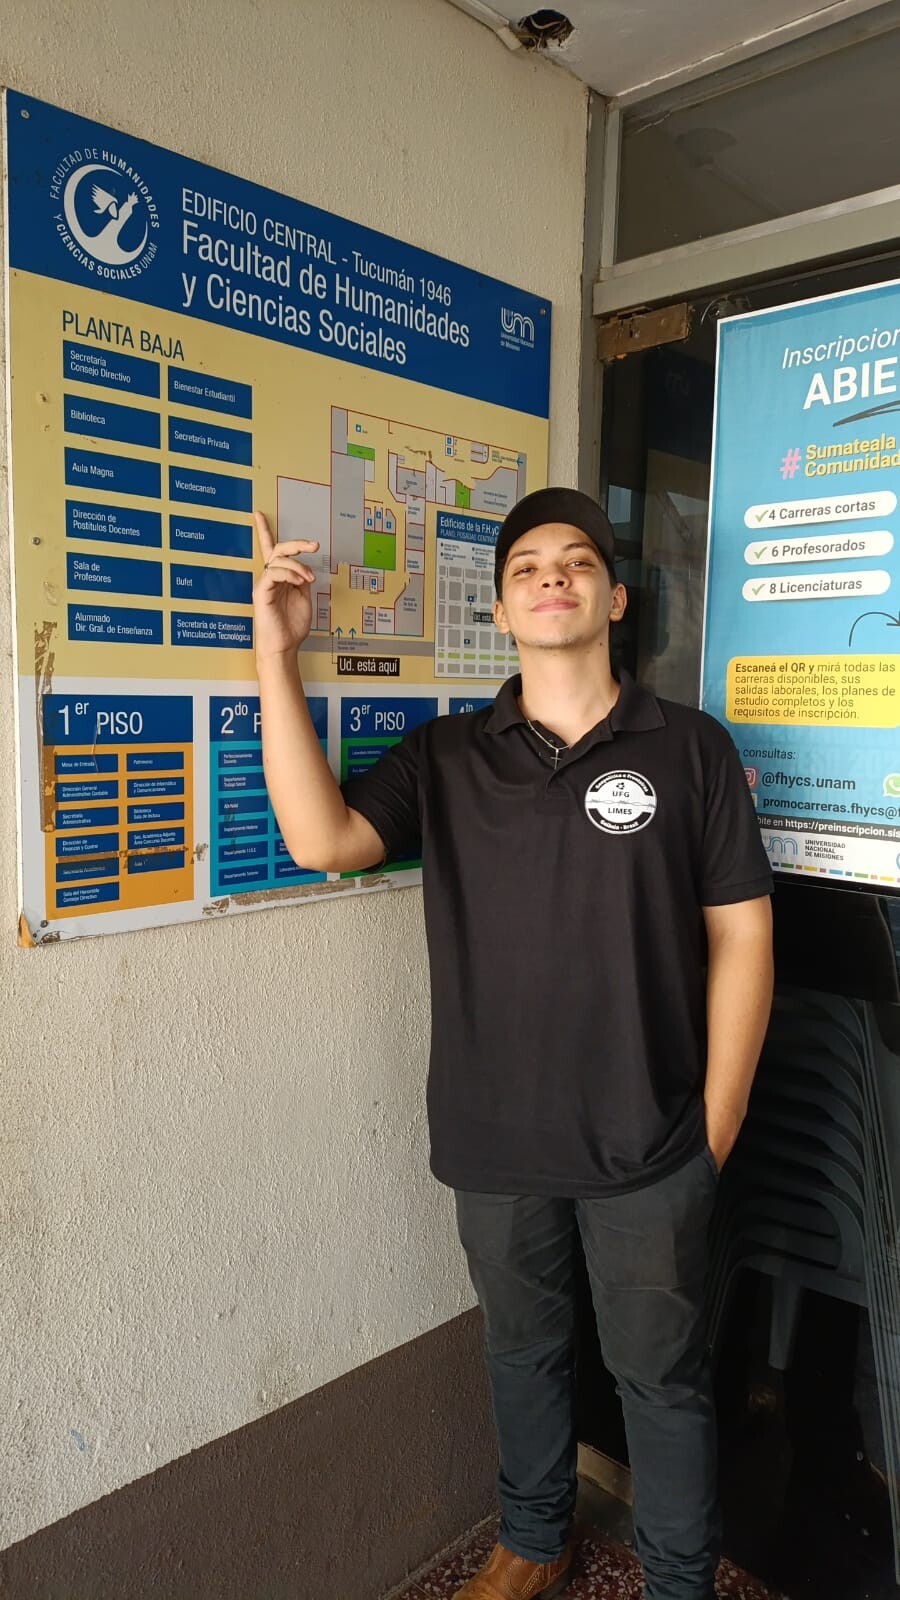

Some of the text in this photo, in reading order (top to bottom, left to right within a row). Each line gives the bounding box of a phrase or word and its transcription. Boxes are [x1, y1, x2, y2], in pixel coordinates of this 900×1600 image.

[50, 148, 160, 229] FACULTAD DE HUMANIDADES
[53, 213, 158, 280] Y CIENCIAS SOCIALES UNaM
[182, 187, 257, 236] EDIFICIO
[263, 218, 337, 265] CENTRAL
[352, 250, 415, 294] Tucumán
[419, 277, 452, 307] 1946
[183, 219, 291, 288] Facultad
[300, 263, 327, 300] de
[335, 273, 470, 348] Humanidades
[182, 272, 407, 365] y Ciencias Sociales
[63, 310, 185, 362] PLANTA BAJA
[70, 350, 107, 367] Secretaría
[70, 362, 131, 383] Consejo Directivo
[803, 356, 899, 410] ABIE
[174, 380, 236, 403] Bienestar Estudiantil
[70, 409, 106, 425] Biblioteca
[174, 430, 230, 450] Secretaría Privada
[780, 433, 897, 480] # Sumateala
[72, 462, 114, 479] Aula Magna
[175, 480, 216, 495] Vicedecanato
[73, 508, 117, 523] Dirección de
[768, 500, 876, 521] 4 Carreras cortas
[73, 519, 141, 537] Postítulos Docentes
[440, 516, 466, 530] Edificios
[466, 521, 474, 532] de
[475, 522, 481, 533] la
[175, 528, 205, 541] Decanato
[771, 539, 866, 558] 6 Profesorados
[73, 560, 100, 572] Sala de
[73, 571, 112, 584] Profesores
[176, 576, 193, 587] Bufet
[769, 579, 863, 594] 8 Licenciaturas
[75, 612, 111, 623] Alumnado
[75, 623, 153, 636] Dir. Gral. de Enseñanza
[176, 619, 246, 632] Secretaría de Extensión
[176, 629, 252, 642] y Vinculación Tecnológica
[339, 657, 398, 676] Ud. está aquí
[735, 661, 896, 674] Escaneá el QR y mirá todas las
[735, 673, 861, 686] carreras disponibles, sus
[735, 684, 896, 699] salidas laborales, los planes de
[734, 696, 854, 709] estudio completos y los
[374, 711, 406, 732] PISO
[733, 707, 860, 721] requisitos de inscripción.
[96, 711, 143, 735] PISO
[743, 748, 796, 760] consultas:
[762, 771, 856, 792] @fhycs.unam
[612, 790, 630, 798] UFG
[607, 807, 633, 815] LIMES
[773, 819, 784, 827] en
[804, 839, 846, 849] UNIVERSIDAD
[804, 845, 836, 854] NACIONAL
[813, 852, 844, 861] MISIONES
